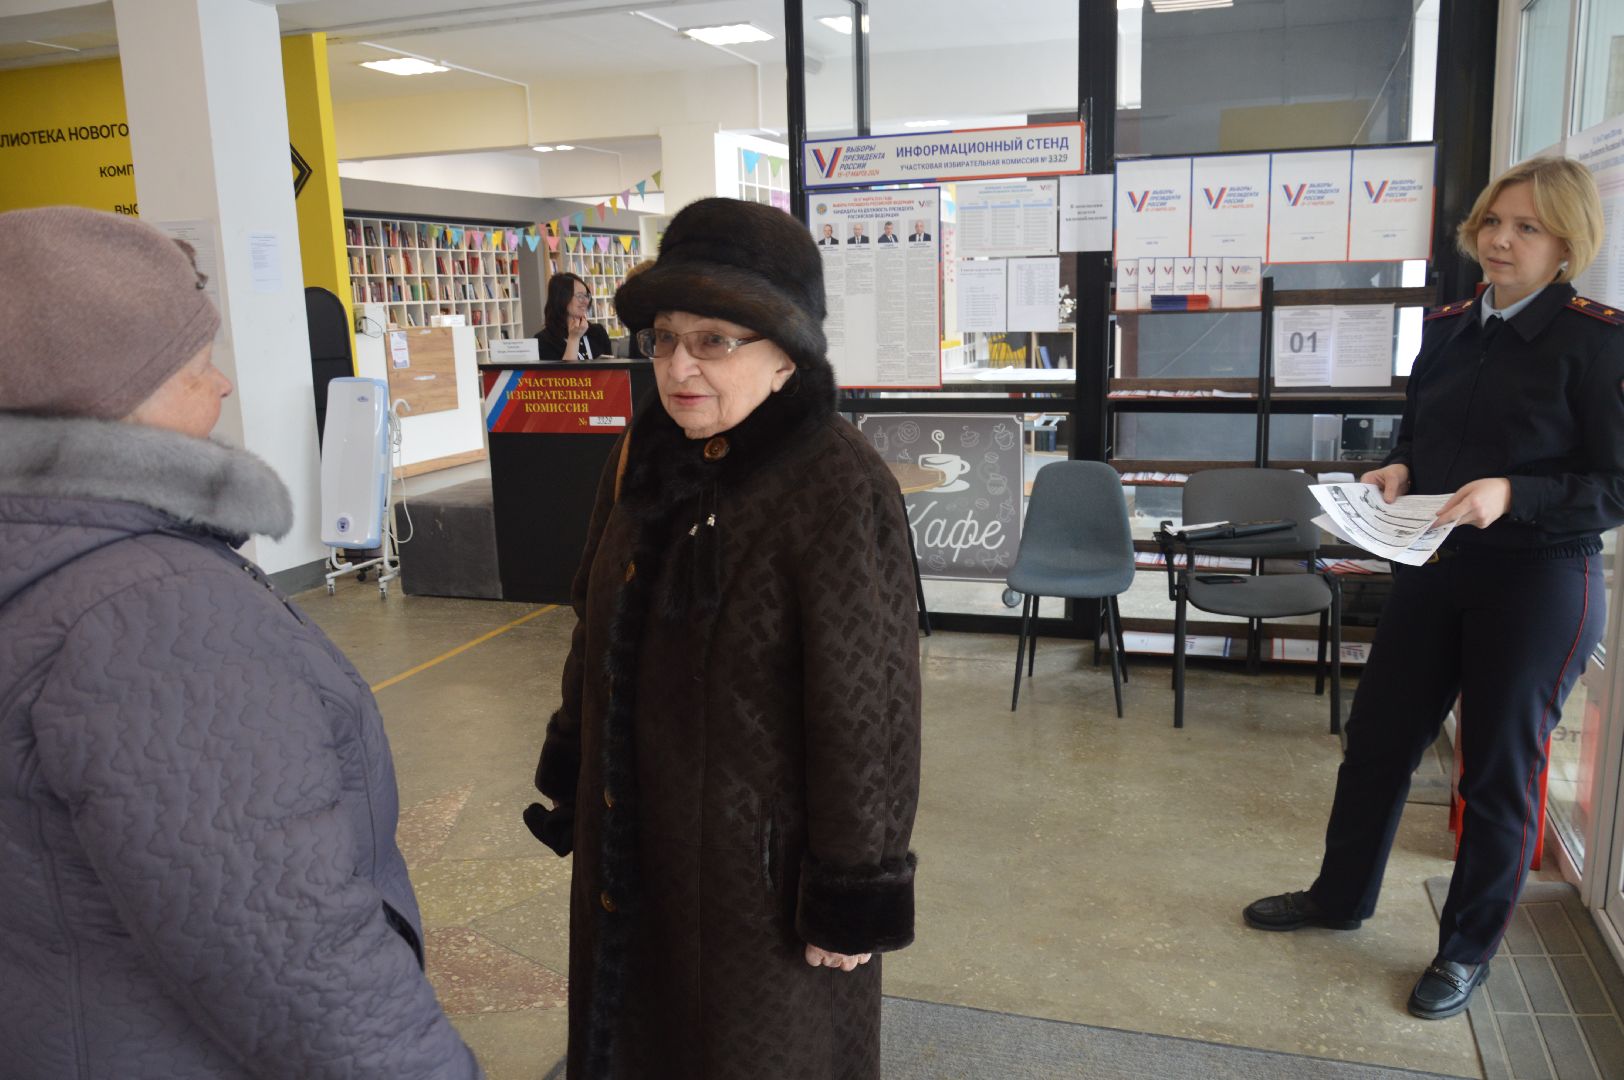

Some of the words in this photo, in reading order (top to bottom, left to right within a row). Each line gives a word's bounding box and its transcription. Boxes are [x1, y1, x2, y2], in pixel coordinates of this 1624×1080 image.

[68, 123, 129, 141] НОВОГО
[845, 144, 876, 153] ВЫБОРЫ
[896, 137, 1023, 158] ИНФОРМАЦИОННЫЙ
[1026, 136, 1069, 151] СТЕНД
[842, 152, 886, 161] ПРЕЗИДЕНТА
[839, 162, 867, 170] РОССИИ
[900, 161, 943, 171] УЧАСТКОВАЯ
[943, 158, 1000, 169] ИЗБИРАТЕЛЬНАЯ
[1001, 156, 1039, 166] КОМИССИЯ
[1289, 331, 1318, 354] 01
[518, 377, 592, 388] УЧАСТКОВАЯ
[505, 390, 604, 400] ИЗБИРАТЕЛЬНАЯ
[525, 403, 589, 413] КОМИССИЯ
[578, 417, 587, 426] №
